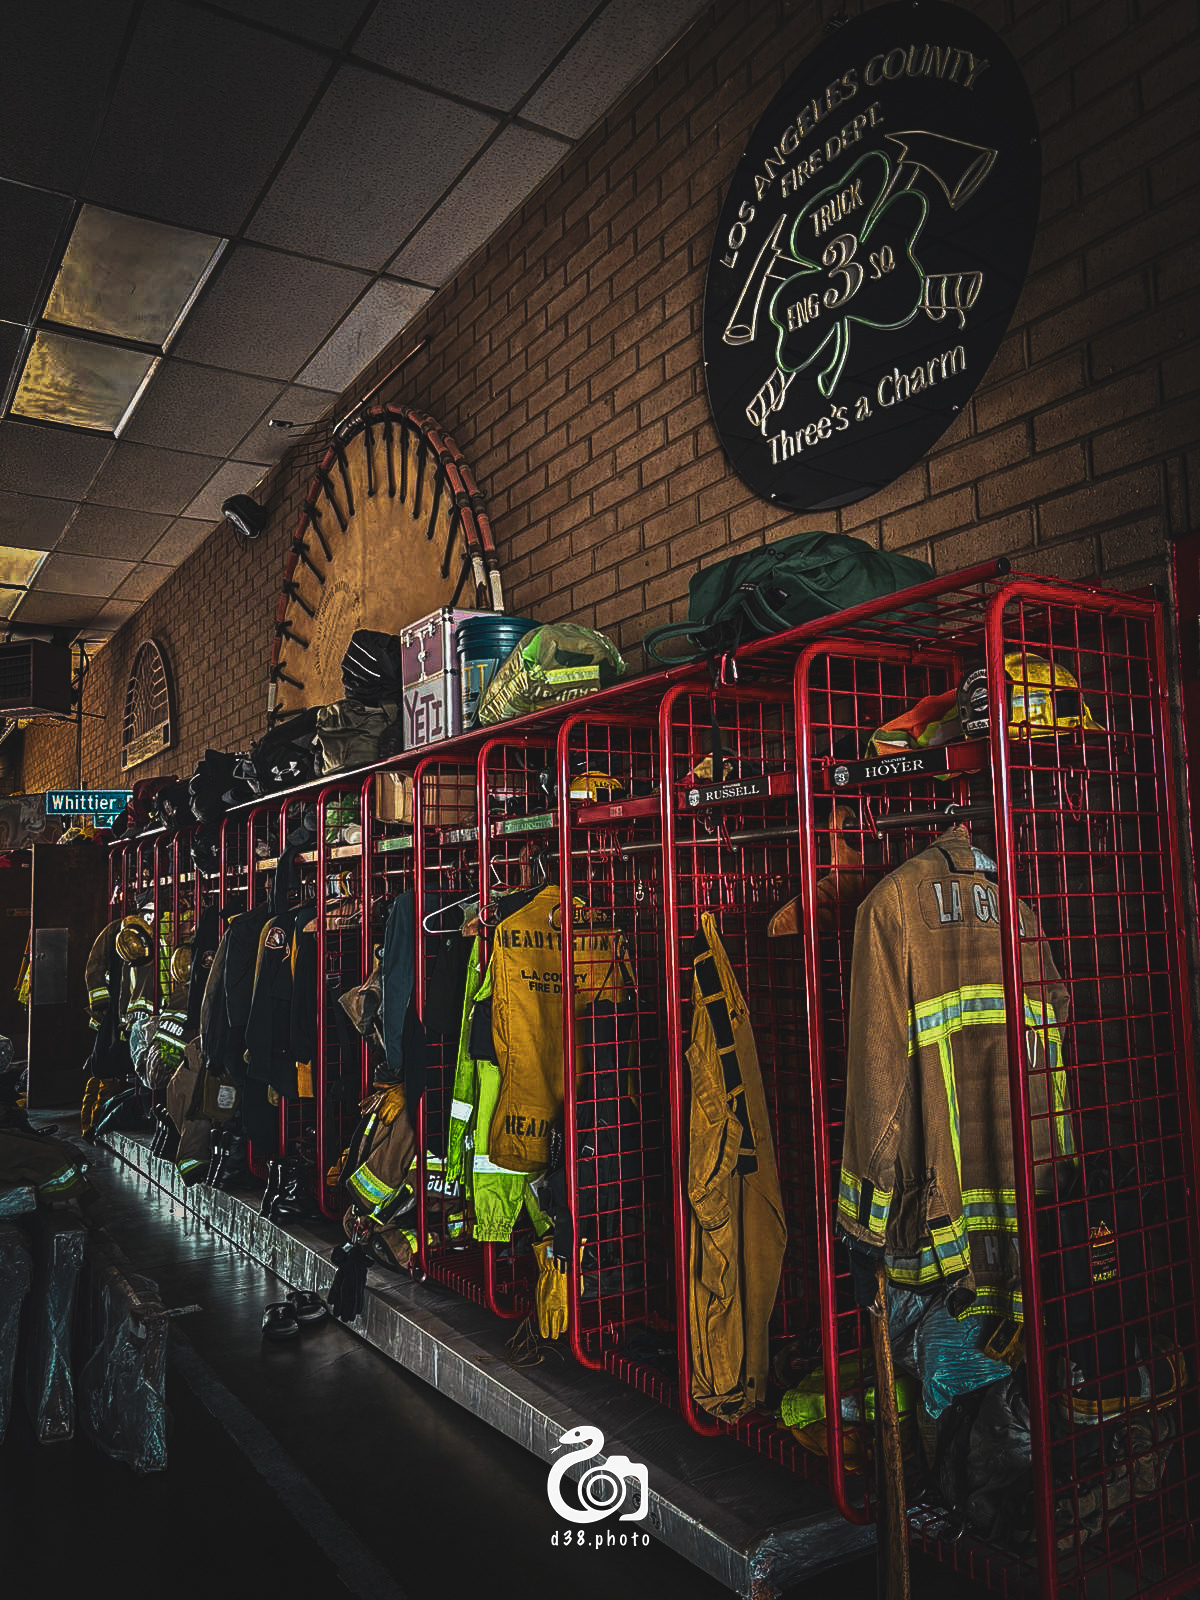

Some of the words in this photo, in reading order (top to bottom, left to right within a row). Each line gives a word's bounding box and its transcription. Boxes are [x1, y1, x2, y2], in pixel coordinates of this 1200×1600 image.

[719, 200, 755, 269] LOS
[753, 68, 858, 202] ANGELES
[864, 43, 990, 90] COUNTY
[780, 148, 823, 198] FIRE
[809, 178, 865, 237] TRUCK
[821, 233, 864, 309] 3
[786, 293, 819, 332] ENG
[766, 403, 850, 465] Three's
[854, 395, 873, 421] a
[877, 345, 967, 408] Charm
[403, 690, 442, 745] YETI
[865, 759, 924, 778] HOYER
[52, 794, 117, 810] Whittier
[706, 784, 760, 801] RUSSELL
[528, 981, 551, 993] FIRE
[543, 971, 588, 984] COTY
